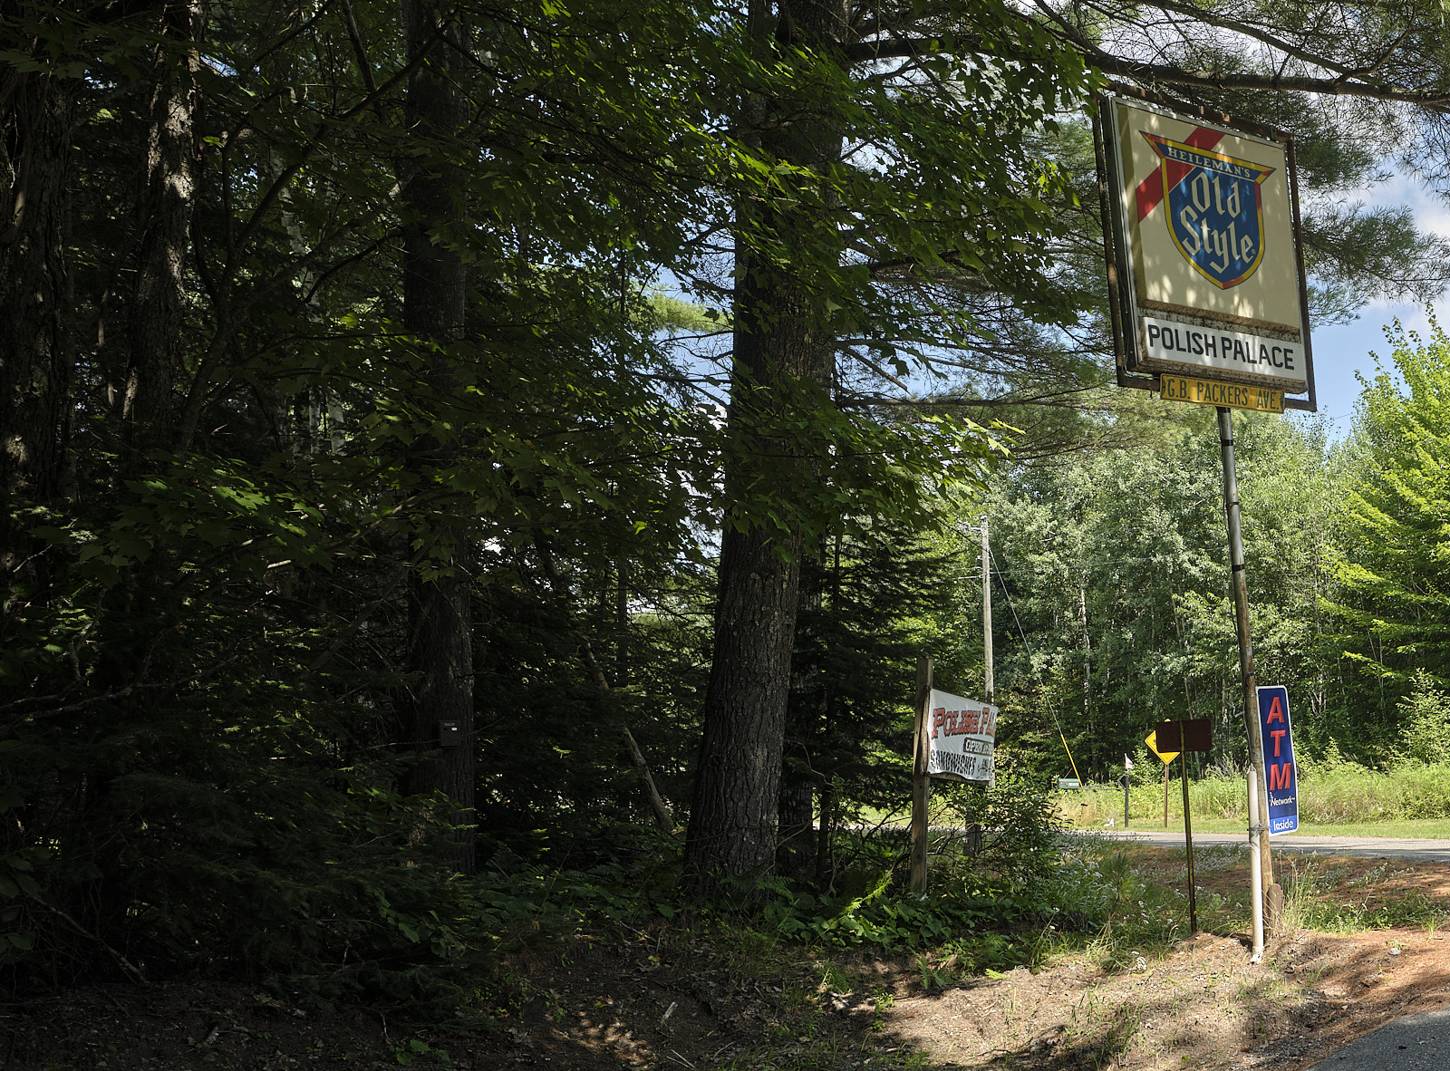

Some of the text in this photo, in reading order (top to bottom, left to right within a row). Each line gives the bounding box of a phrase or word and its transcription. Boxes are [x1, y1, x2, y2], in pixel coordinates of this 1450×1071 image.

[1167, 147, 1251, 178] HEILEMAN'S
[1191, 171, 1241, 218] Old
[1180, 205, 1254, 274] Style
[1148, 324, 1295, 370] POLISH PALACE
[1167, 378, 1280, 410] G.B. PACKERS AVE.
[1266, 696, 1292, 791] ATM
[1273, 818, 1294, 831] Inside
